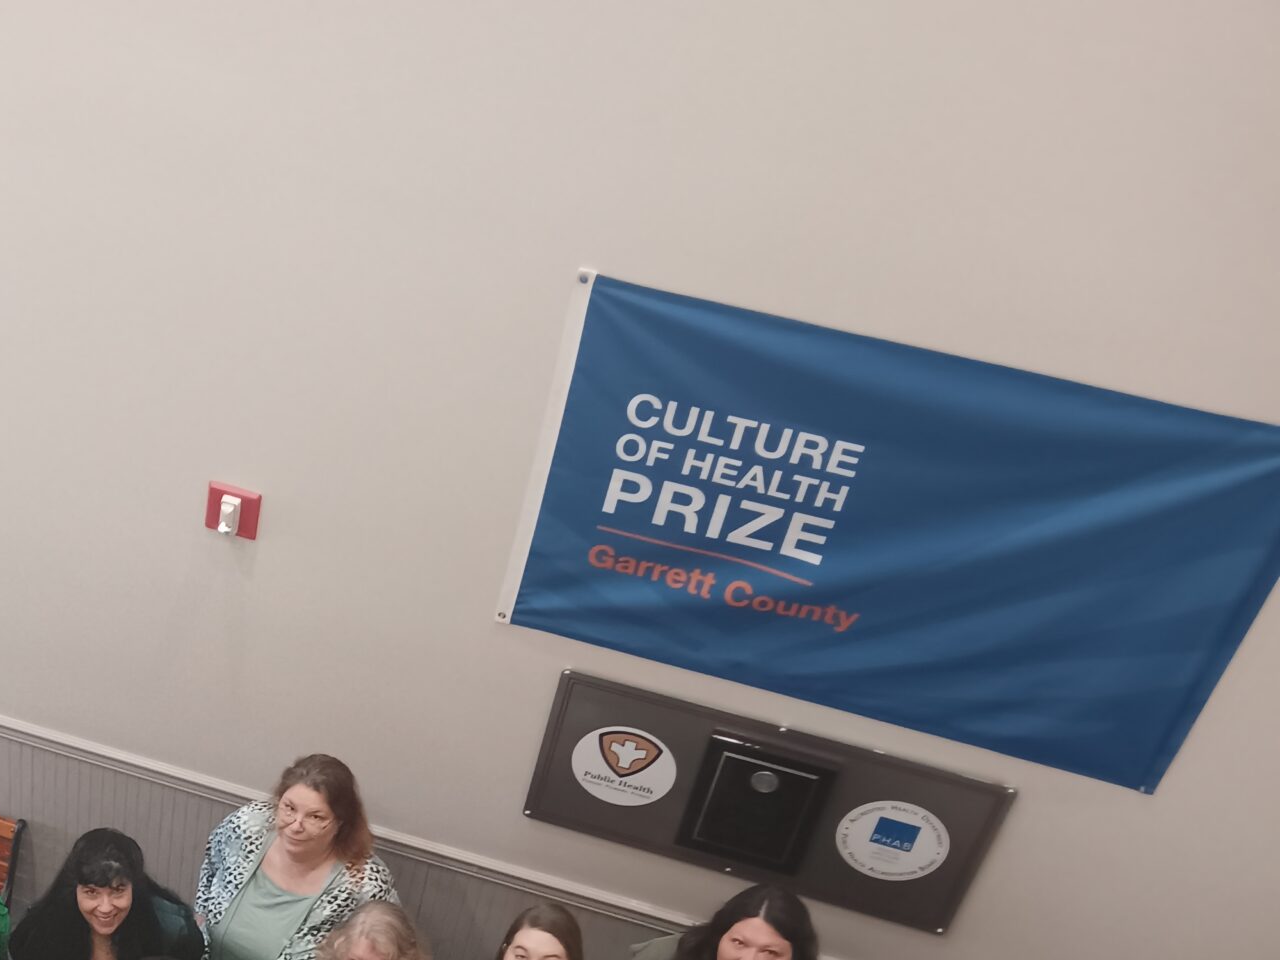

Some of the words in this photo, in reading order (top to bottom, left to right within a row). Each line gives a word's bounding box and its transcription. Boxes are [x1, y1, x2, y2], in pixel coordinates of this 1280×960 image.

[615, 433, 675, 467] OF
[681, 449, 850, 512] HEALTH
[626, 393, 865, 478] CULTURE
[601, 468, 835, 566] PRIZE
[588, 544, 717, 599] Garrett
[724, 581, 861, 633] County
[583, 770, 616, 784] Public
[618, 780, 654, 795] Health
[871, 833, 912, 850] PHAB
